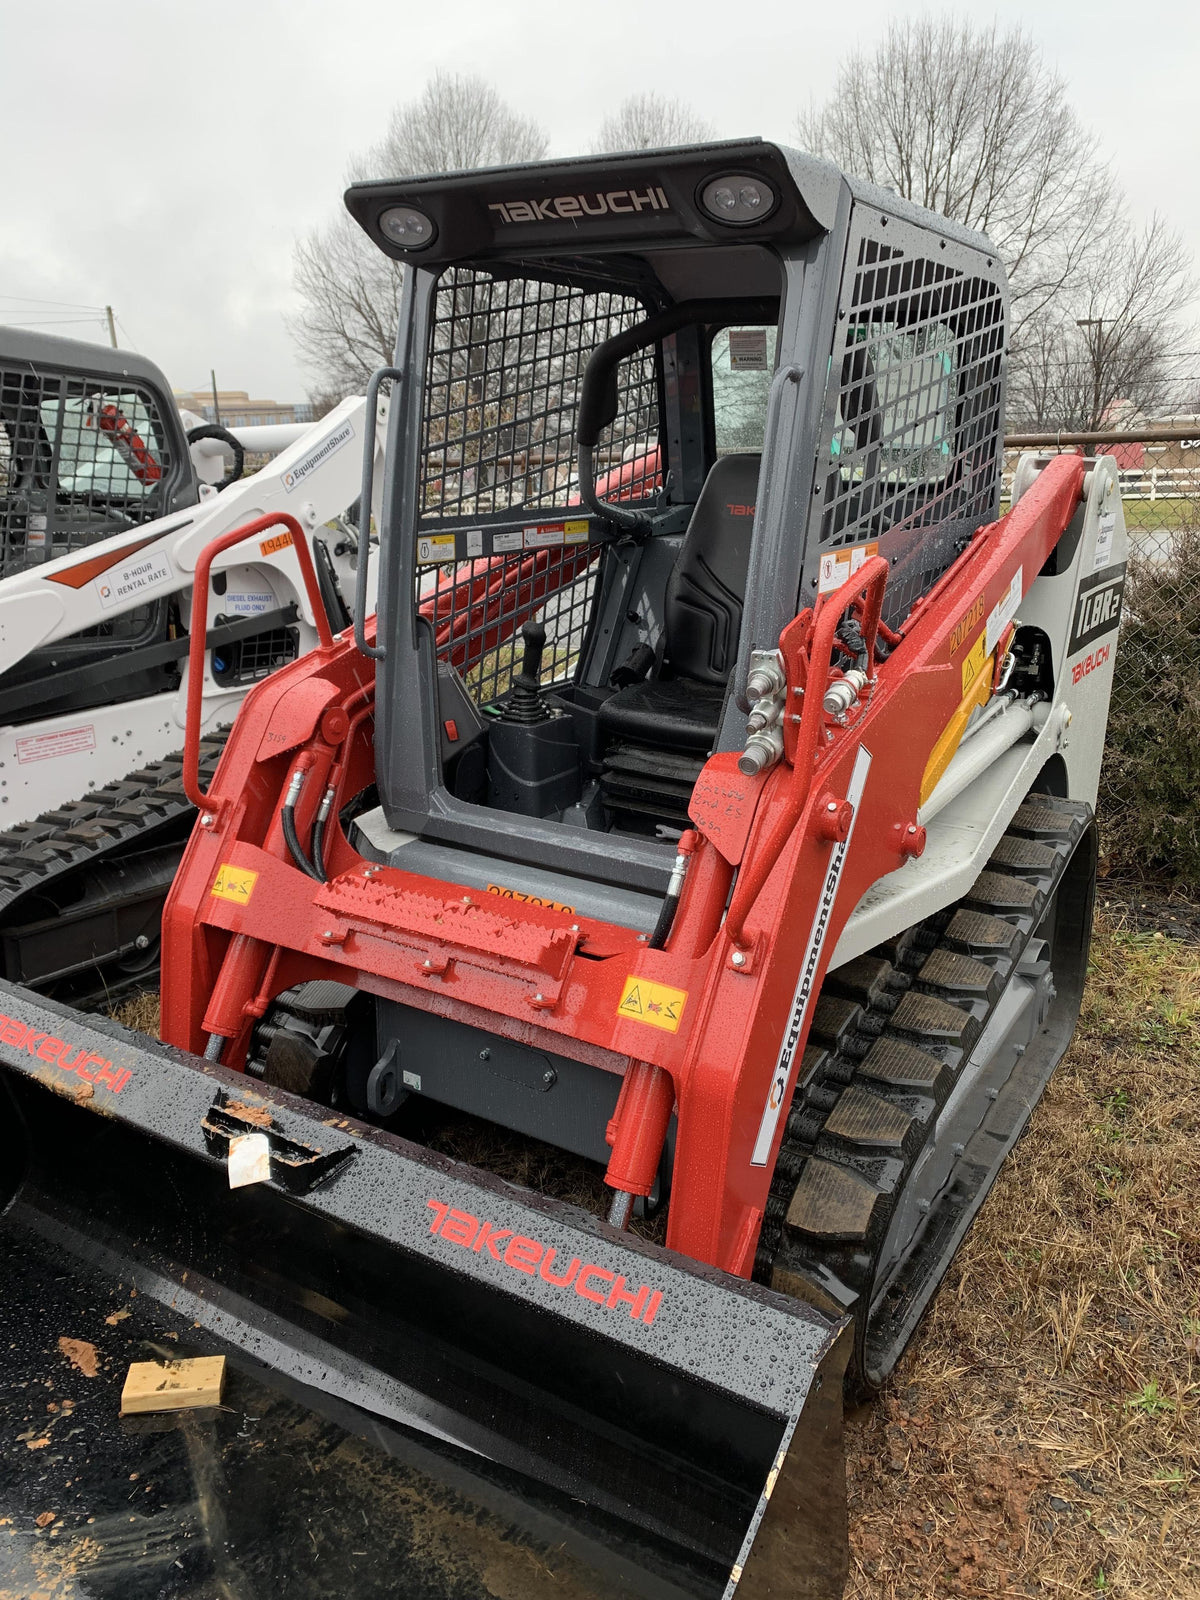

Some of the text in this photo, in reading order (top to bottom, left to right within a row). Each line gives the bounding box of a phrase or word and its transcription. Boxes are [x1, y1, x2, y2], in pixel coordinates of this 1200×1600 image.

[293, 428, 351, 480] EquipmentShare
[117, 568, 167, 596] RENTAL RATE
[123, 562, 153, 581] 8-HOUR
[247, 594, 273, 602] EXHAUST
[779, 836, 848, 1072] EquipmentSha
